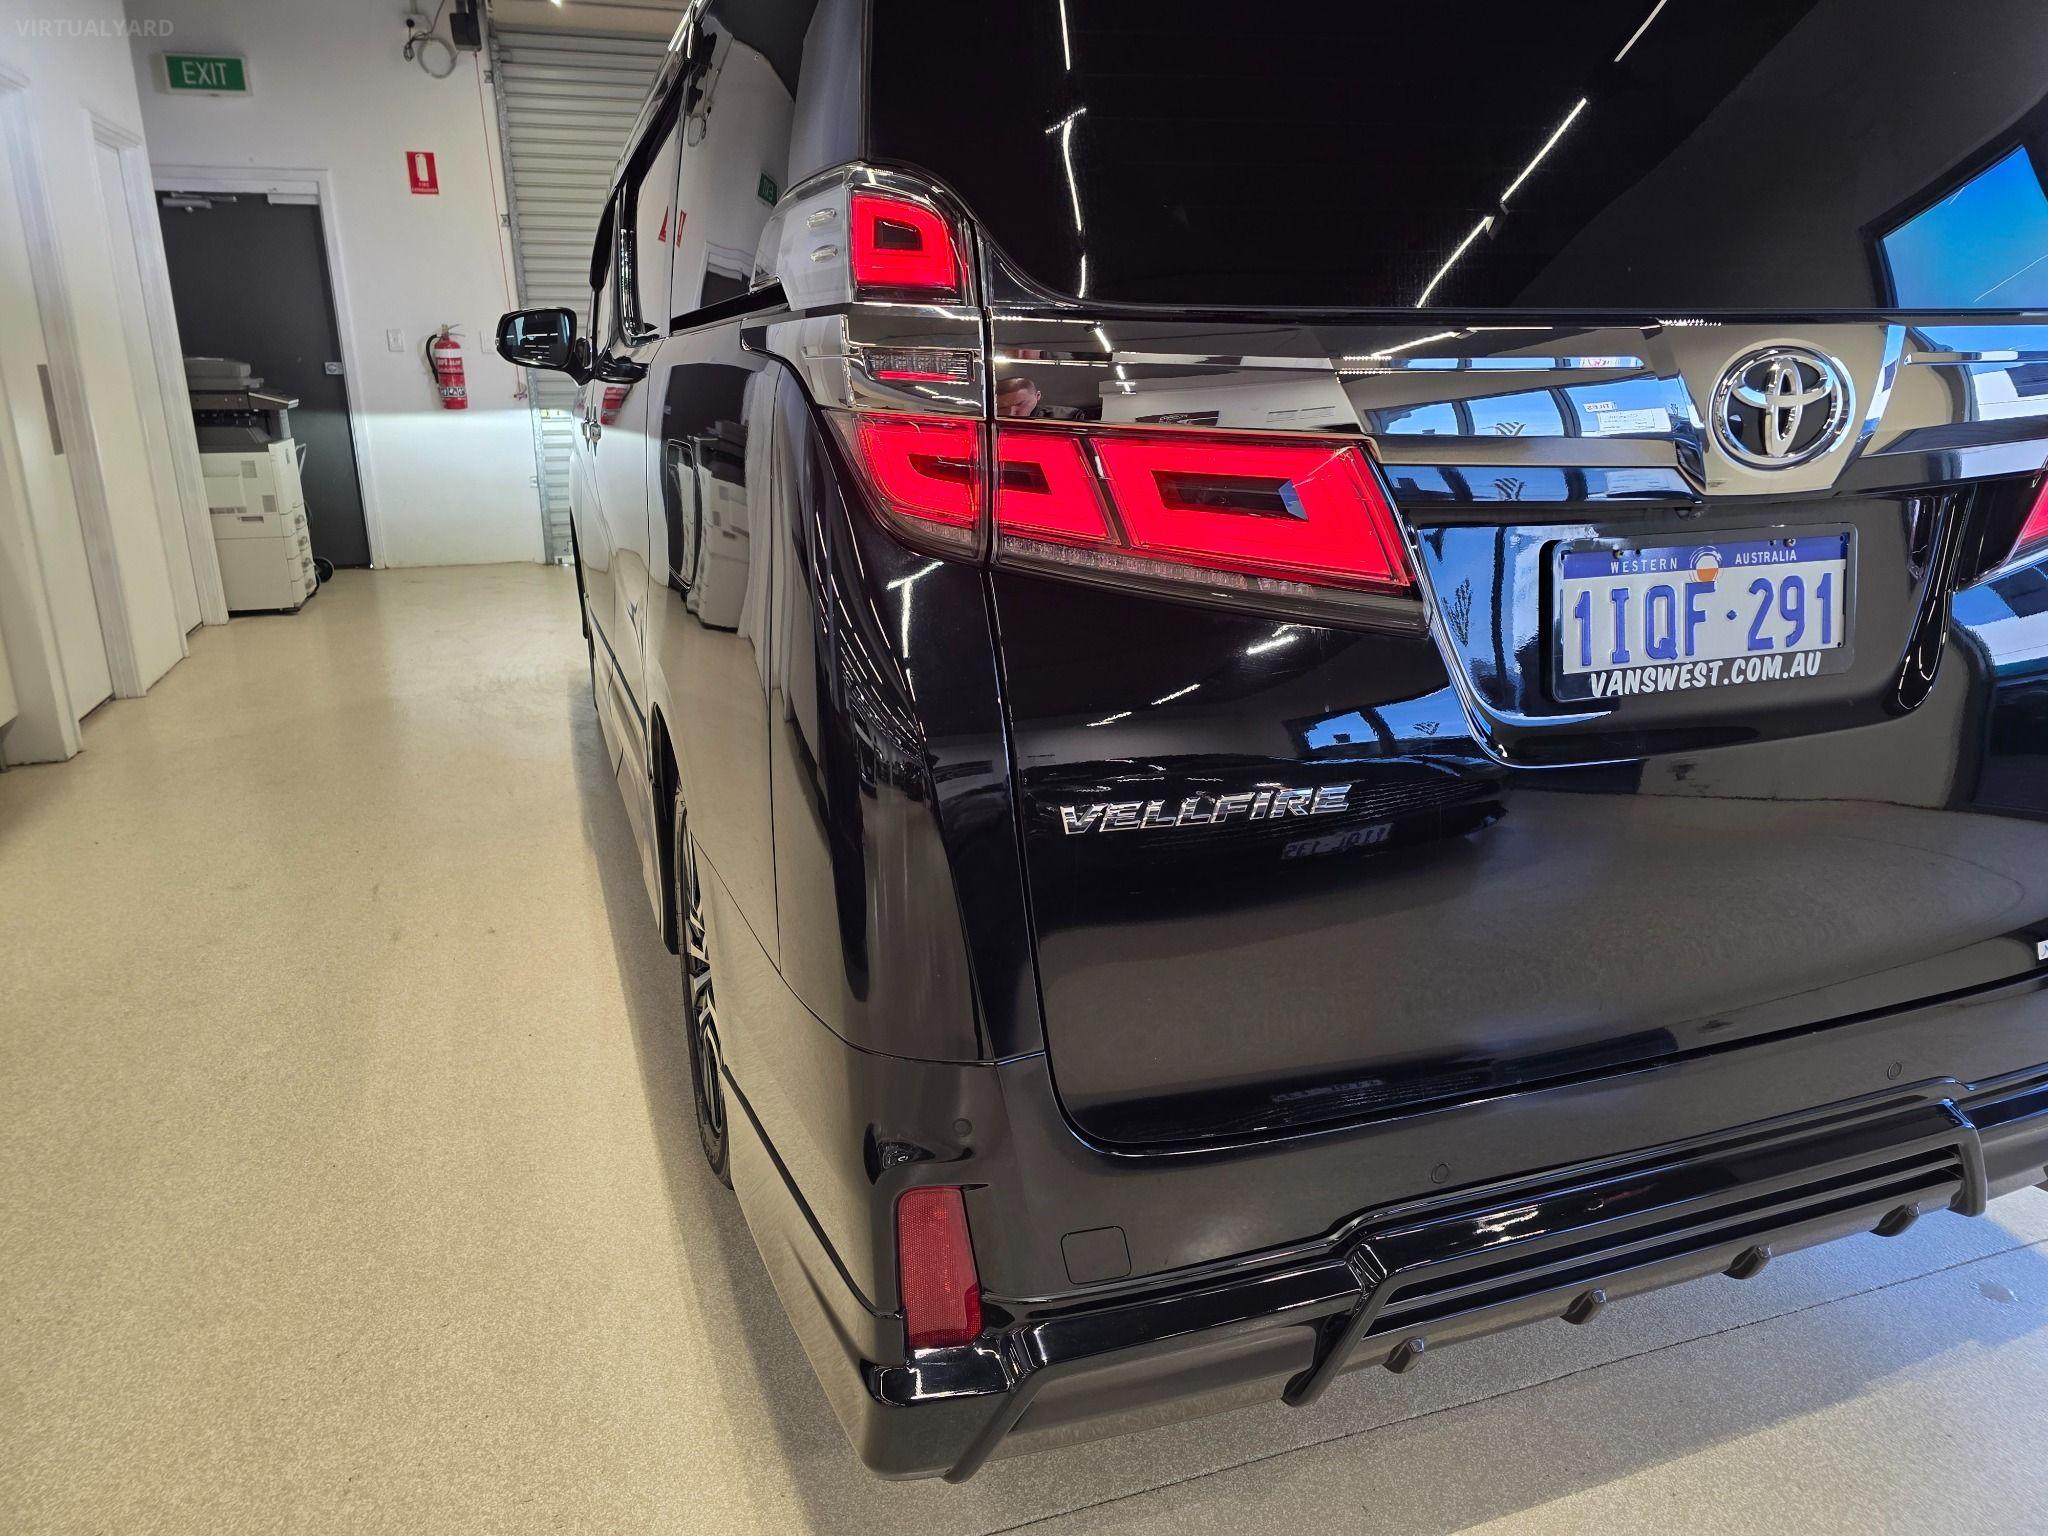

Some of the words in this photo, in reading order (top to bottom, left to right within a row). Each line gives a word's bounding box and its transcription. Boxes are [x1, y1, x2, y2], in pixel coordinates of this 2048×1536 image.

[182, 61, 227, 85] EXIT
[1611, 558, 1678, 573] WESTERN
[1735, 550, 1797, 565] AUSTRALIA
[1591, 652, 1822, 697] VANSWEST.COM.AU
[1059, 784, 1352, 834] VELLFIRE
